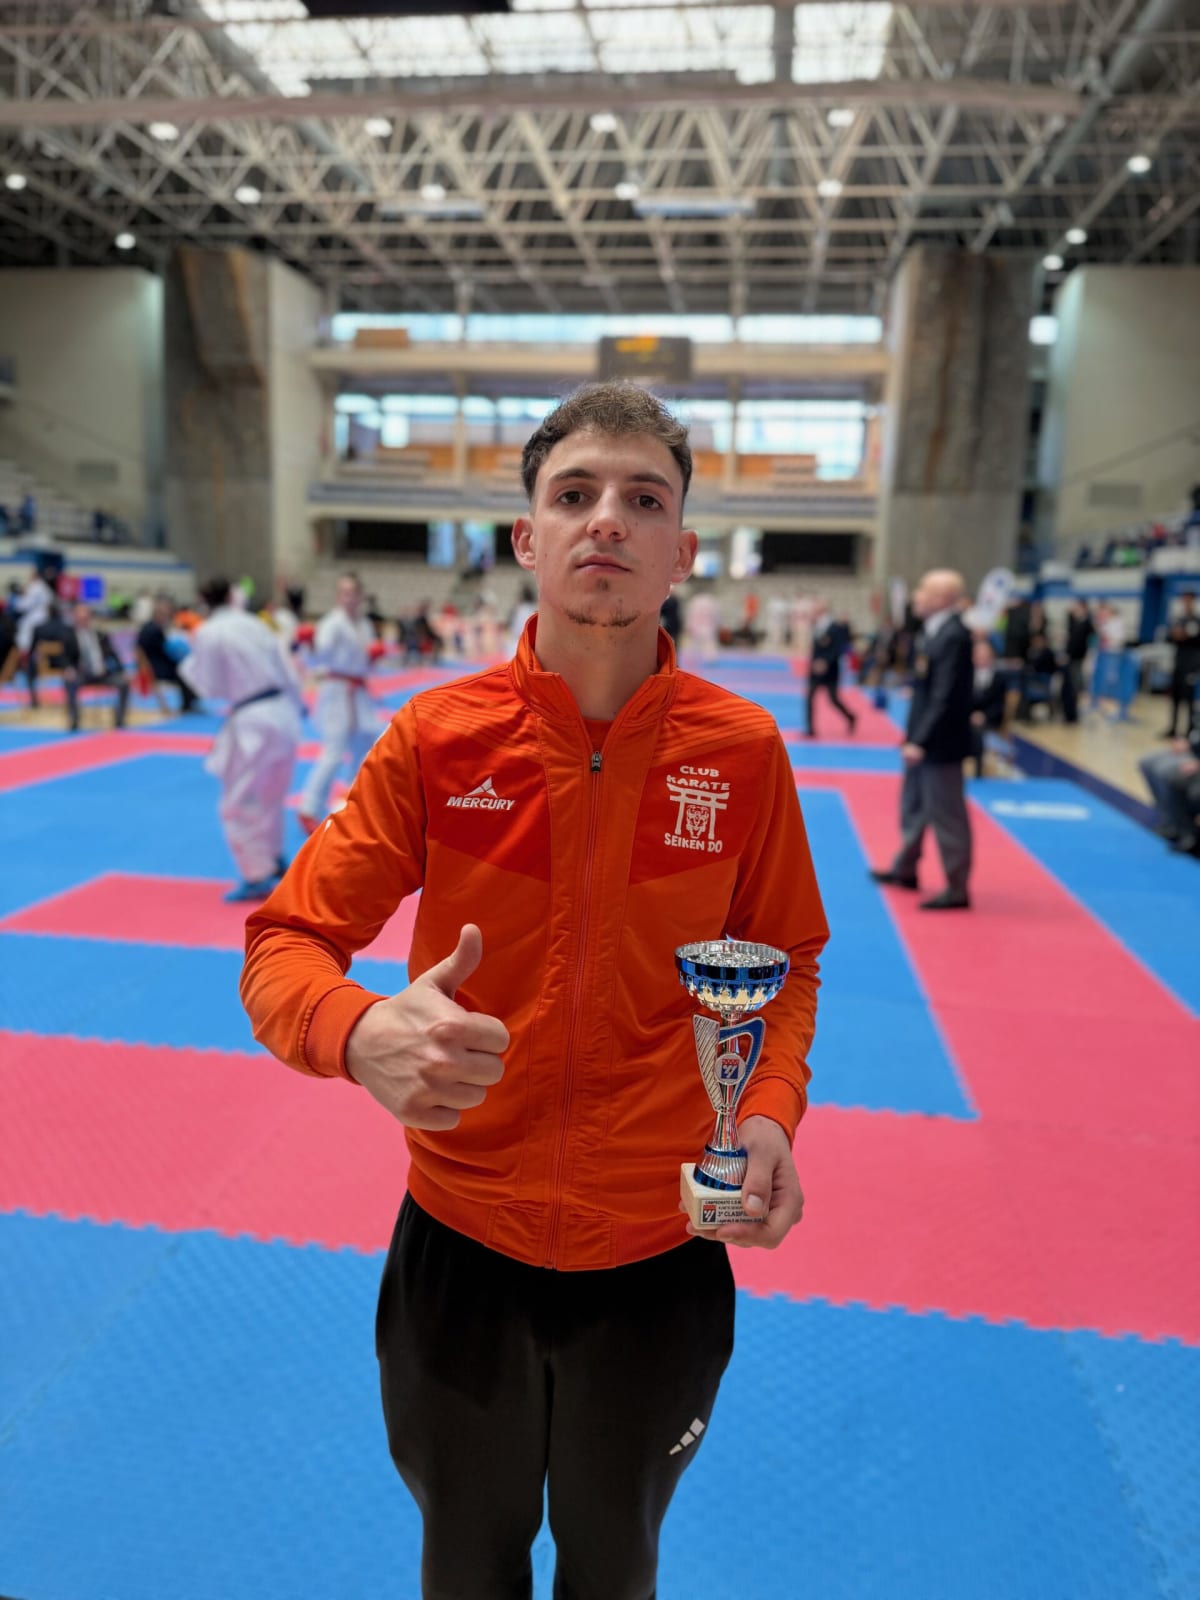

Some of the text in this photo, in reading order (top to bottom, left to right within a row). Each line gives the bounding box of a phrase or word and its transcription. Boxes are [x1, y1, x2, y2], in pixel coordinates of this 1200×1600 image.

[680, 765, 720, 777] CLUB
[666, 774, 731, 791] KARATE
[446, 796, 516, 811] MERCURY
[664, 832, 723, 853] SEIKEN DO
